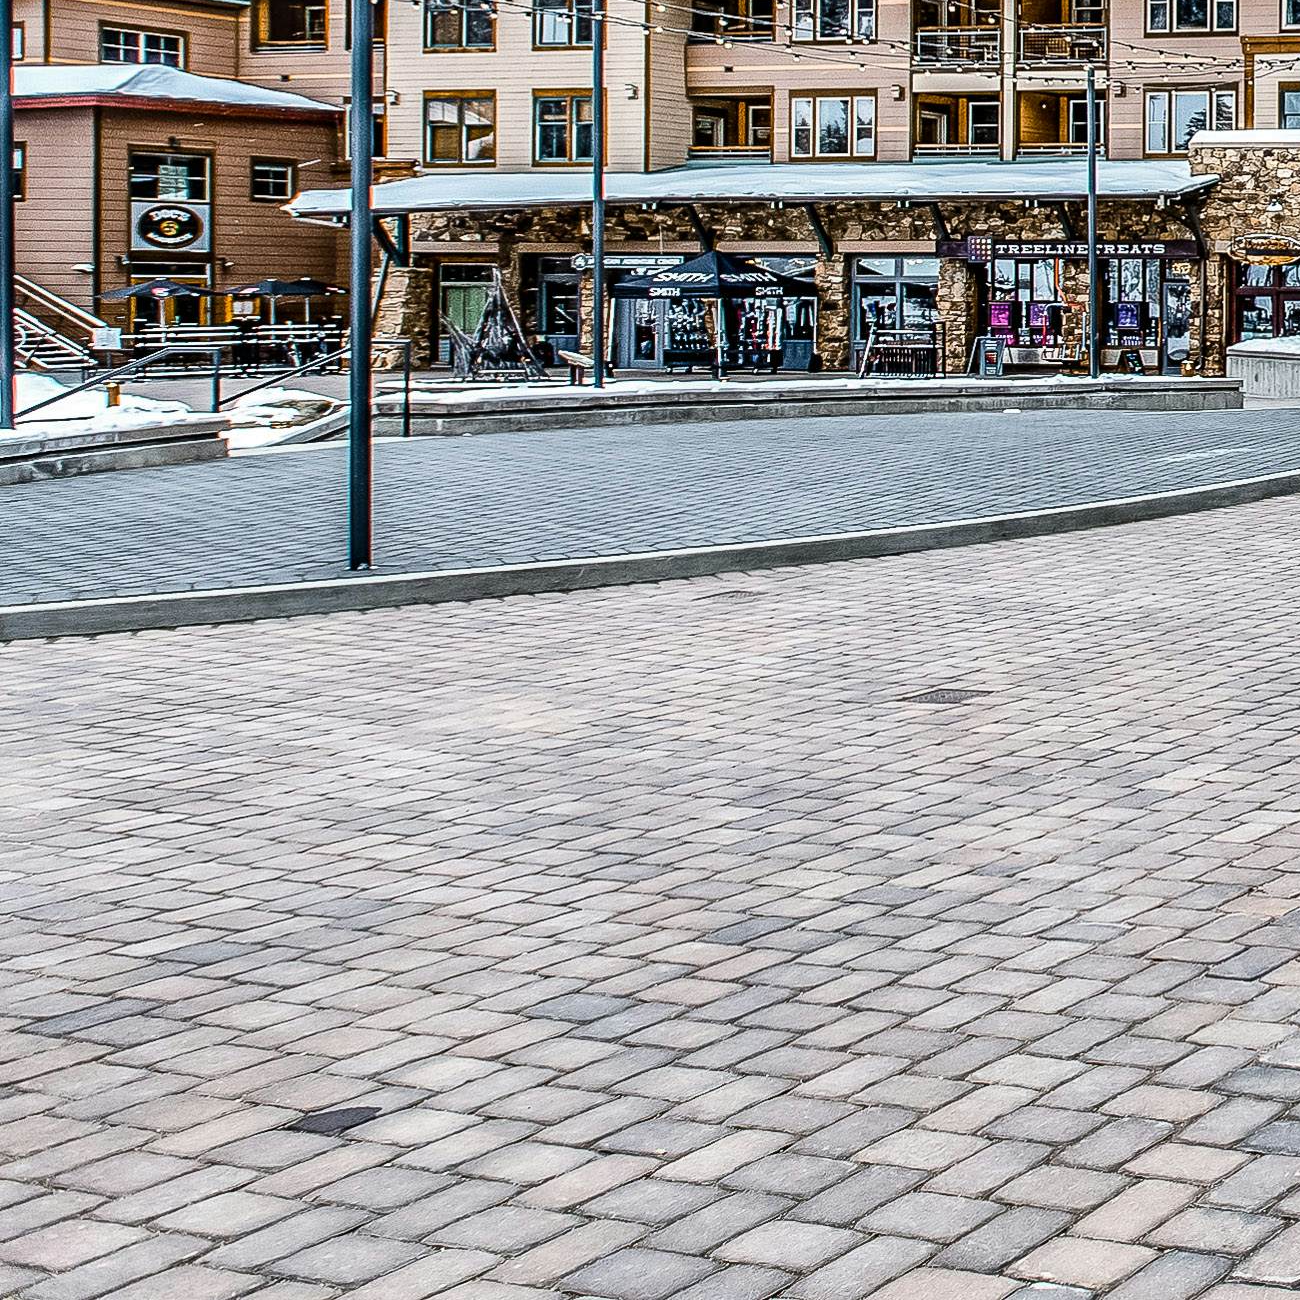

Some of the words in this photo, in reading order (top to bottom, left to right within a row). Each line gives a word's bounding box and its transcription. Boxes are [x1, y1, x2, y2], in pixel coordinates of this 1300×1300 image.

[995, 244, 1088, 254] TREELINE
[653, 273, 714, 282] SMITH
[720, 272, 778, 282] SMITH
[649, 288, 680, 296] SMITH
[755, 287, 783, 295] SMITH
